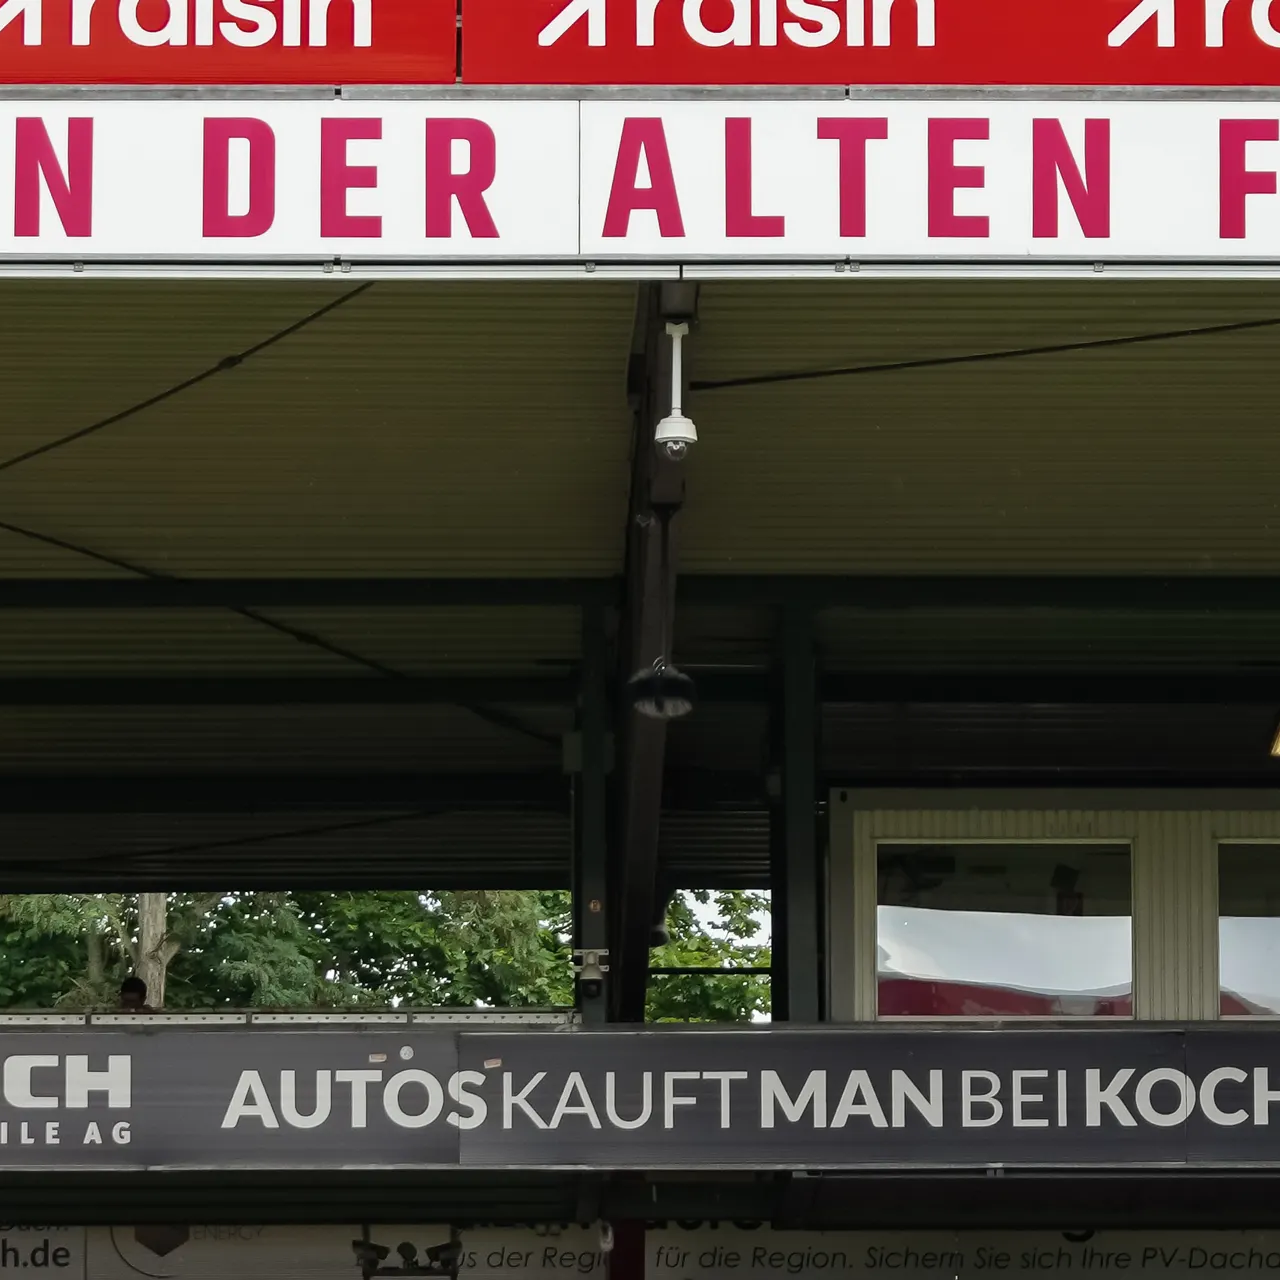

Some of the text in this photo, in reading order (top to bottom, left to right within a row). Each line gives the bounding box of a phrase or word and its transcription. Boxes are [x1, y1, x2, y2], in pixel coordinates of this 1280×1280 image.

[202, 117, 499, 239] DER
[602, 117, 1111, 239] ALTEN
[82, 1121, 132, 1146] AG
[486, 1244, 533, 1270] der
[654, 1244, 694, 1270] für
[698, 1245, 740, 1270] die
[751, 1245, 855, 1276] Region.
[864, 1245, 965, 1271] Sichern
[974, 1245, 1013, 1270] Sie
[1020, 1245, 1074, 1270] sich
[1081, 1245, 1136, 1270] Ihre
